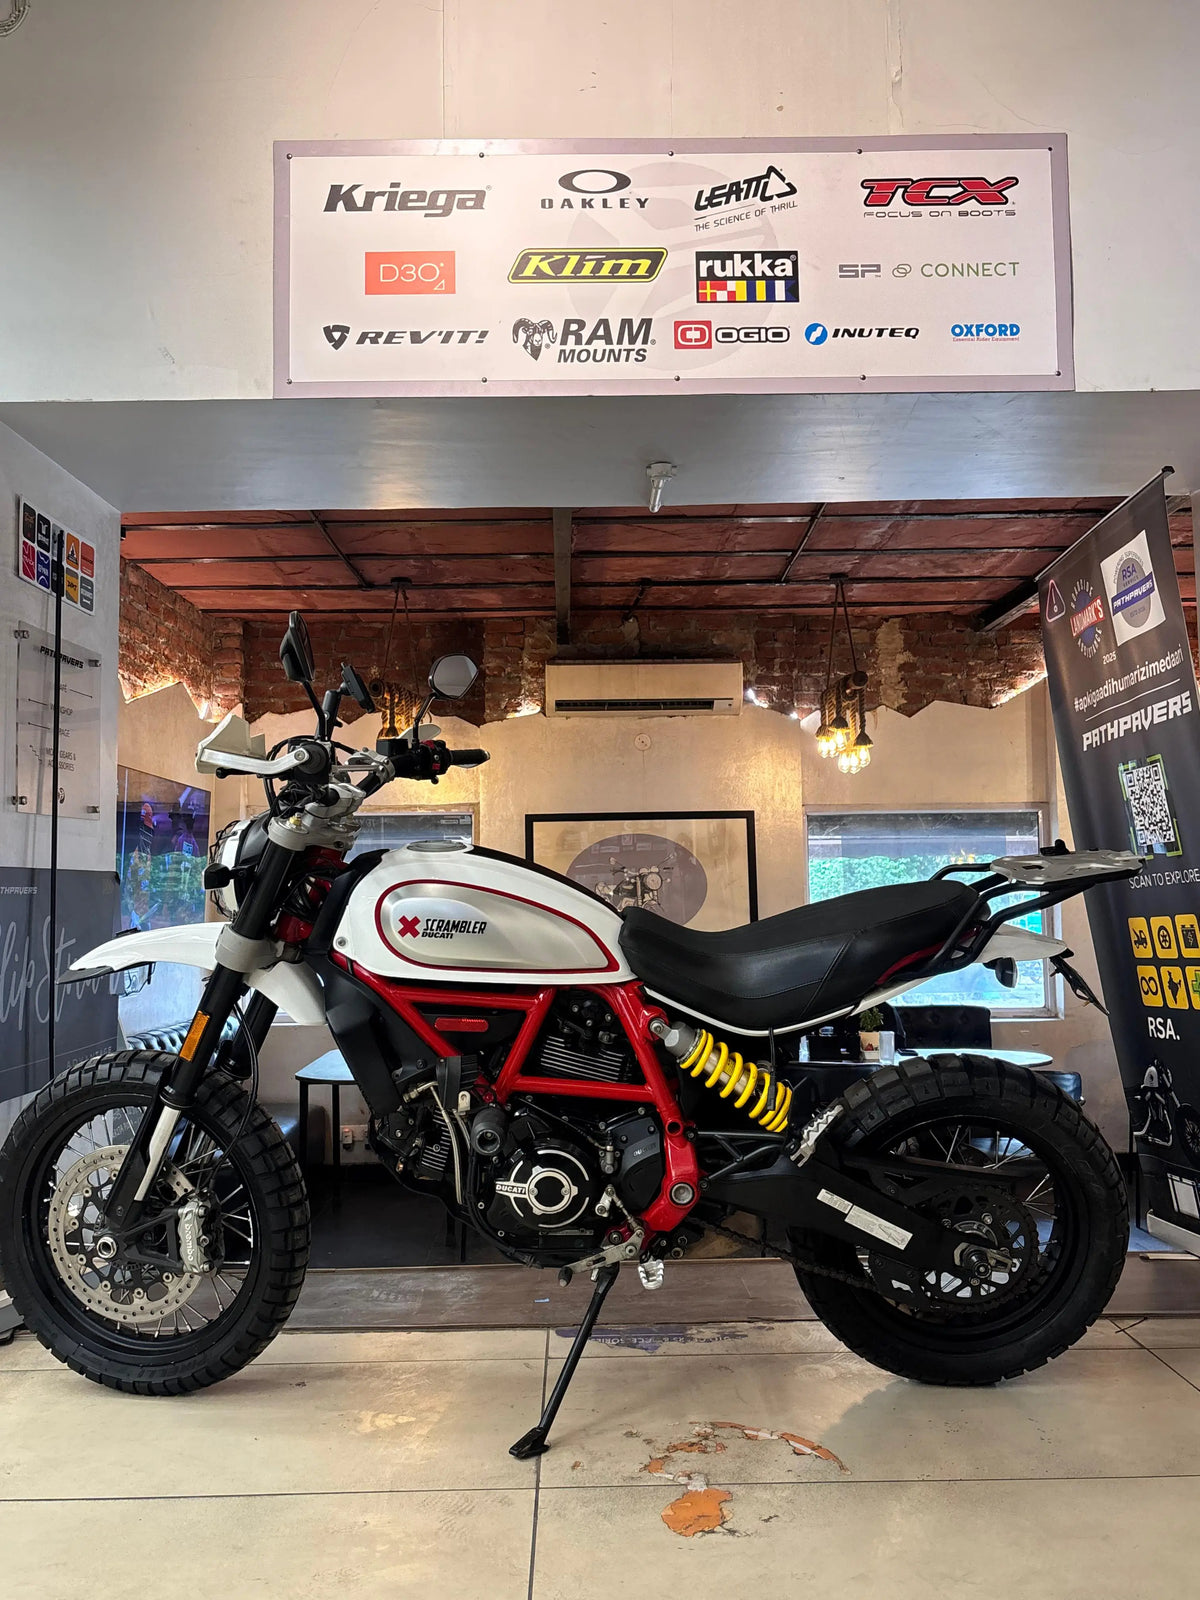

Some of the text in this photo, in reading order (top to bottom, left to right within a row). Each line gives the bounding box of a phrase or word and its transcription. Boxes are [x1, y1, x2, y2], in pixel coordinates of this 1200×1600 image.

[323, 182, 485, 217] Kriega
[861, 177, 1019, 207] TCX
[540, 197, 649, 210] OAKLEY
[694, 200, 798, 232] THE SCIENCE OF THRILL
[863, 209, 1016, 218] FOCUS ON BOOTS
[699, 253, 794, 278] rukka
[838, 261, 1020, 279] SP CONNECT
[356, 329, 490, 346] REV'IT!
[559, 317, 654, 346] RAM
[715, 326, 790, 344] OGIO
[831, 326, 920, 340] INUTEQ
[951, 323, 1020, 337] OXFORD
[557, 348, 647, 363] MOUNTS
[1122, 563, 1137, 581] RSA
[1112, 580, 1153, 610] PATHPAVERS
[1070, 598, 1104, 637] LANDMARK'S
[1102, 651, 1117, 665] 2025
[1082, 690, 1193, 752] PATHPAVERS
[1129, 868, 1200, 889] SCAN TO EXPLORE
[421, 931, 453, 939] DUCATI
[423, 918, 488, 934] SCRAMBLER
[1147, 1016, 1181, 1041] RSA.
[496, 1184, 526, 1194] DUCATI
[184, 1223, 195, 1262] brembo
